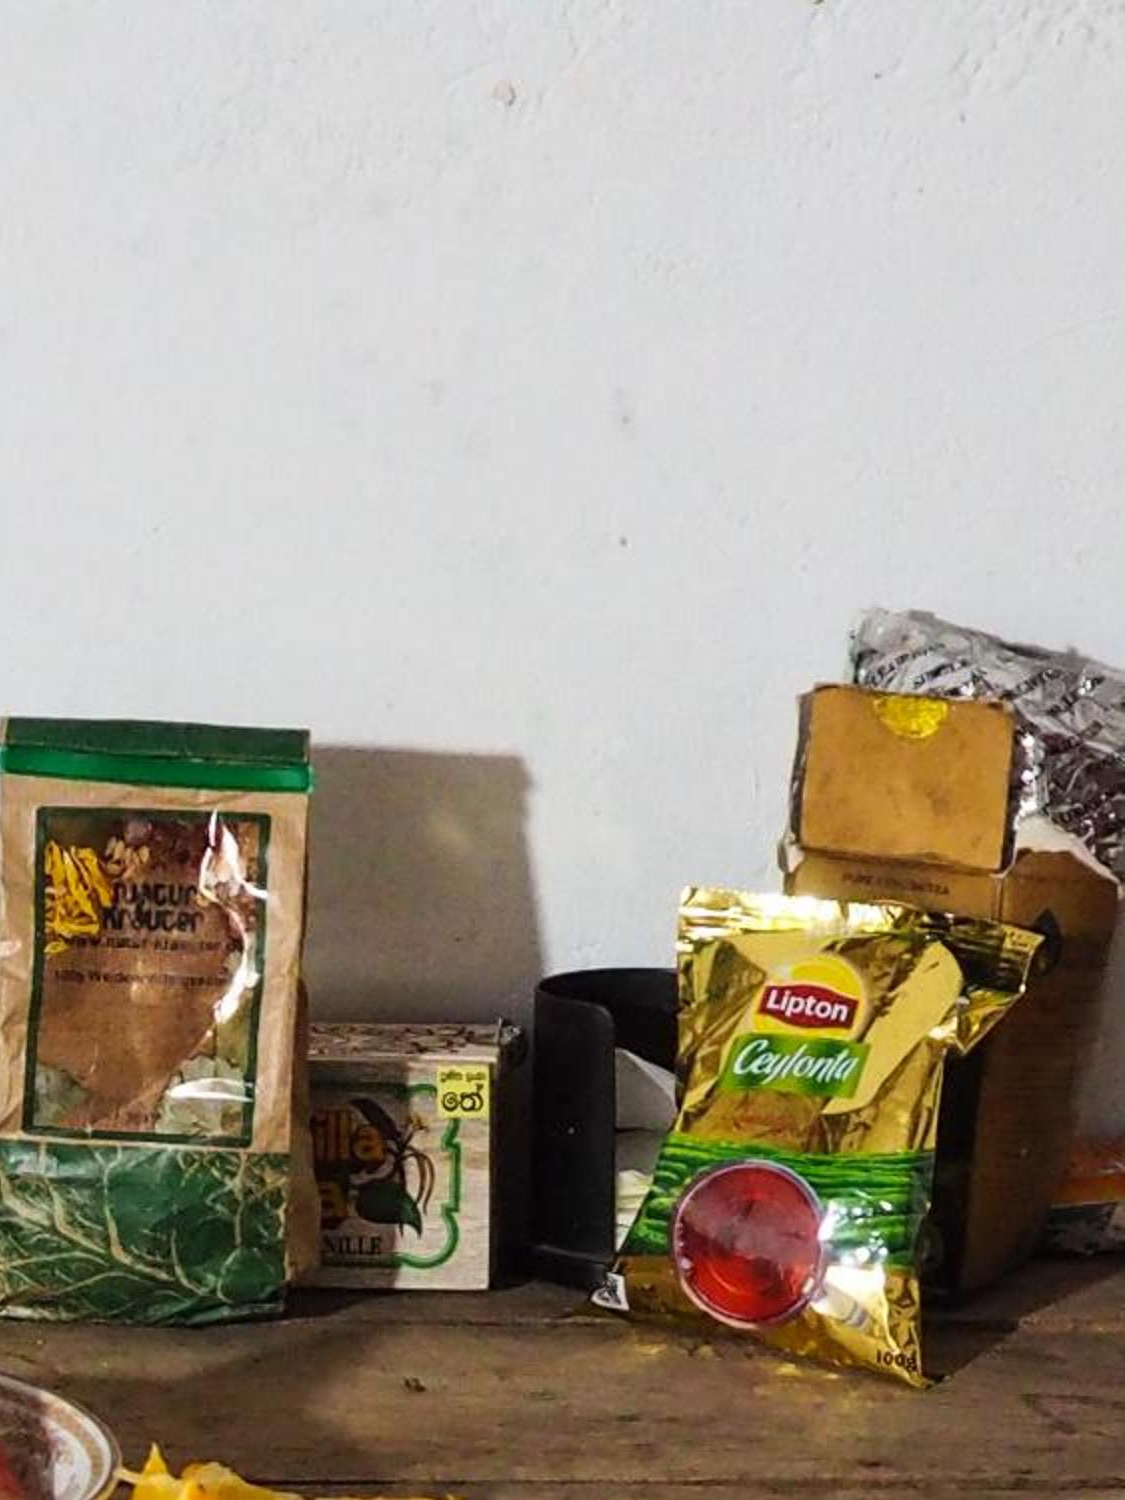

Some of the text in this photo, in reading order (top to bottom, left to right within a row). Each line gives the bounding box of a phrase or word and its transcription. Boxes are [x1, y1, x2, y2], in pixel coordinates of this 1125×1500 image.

[766, 989, 849, 1022] Lipton
[733, 1040, 859, 1085] Ceylonta
[876, 1350, 917, 1372] 100g
